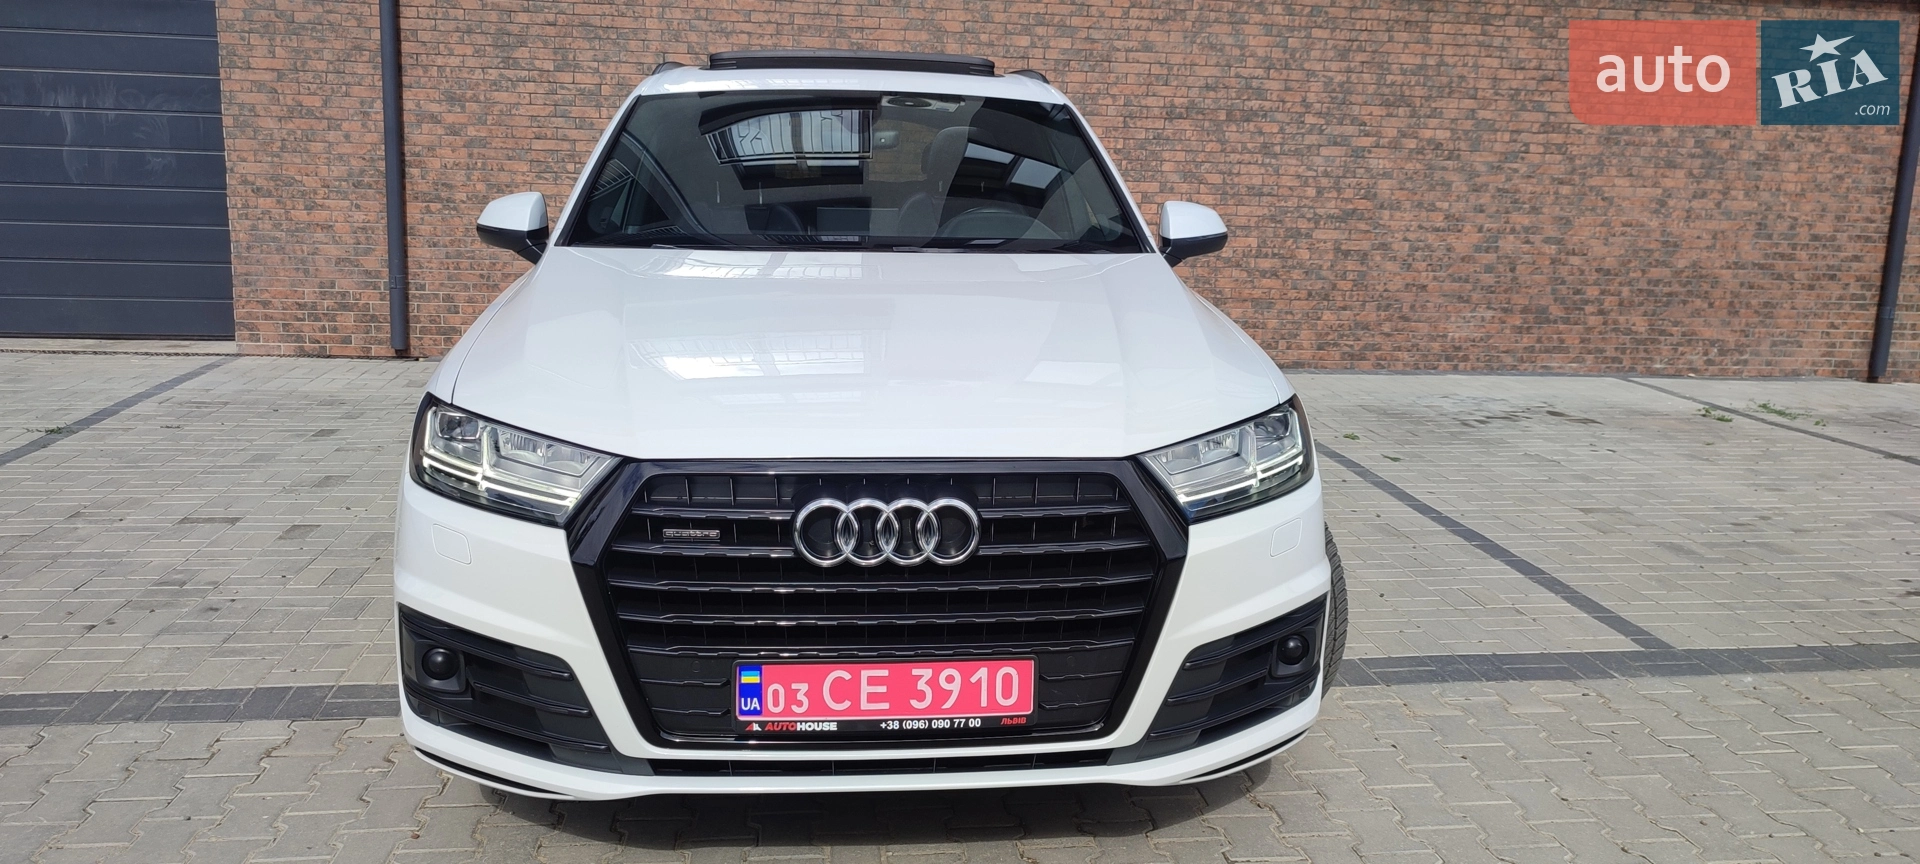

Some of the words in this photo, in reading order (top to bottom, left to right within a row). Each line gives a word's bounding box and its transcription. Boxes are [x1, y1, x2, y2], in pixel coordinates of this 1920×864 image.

[665, 530, 717, 538] quattro
[767, 683, 809, 714] 03
[822, 670, 890, 710] CE
[909, 666, 1019, 709] 3910
[741, 698, 761, 711] UA
[764, 722, 838, 731] AUTOHOUSE
[880, 721, 900, 730] +38
[902, 720, 929, 731] (096)
[931, 719, 950, 729] 090
[953, 719, 966, 728] 77
[968, 718, 981, 728] 00
